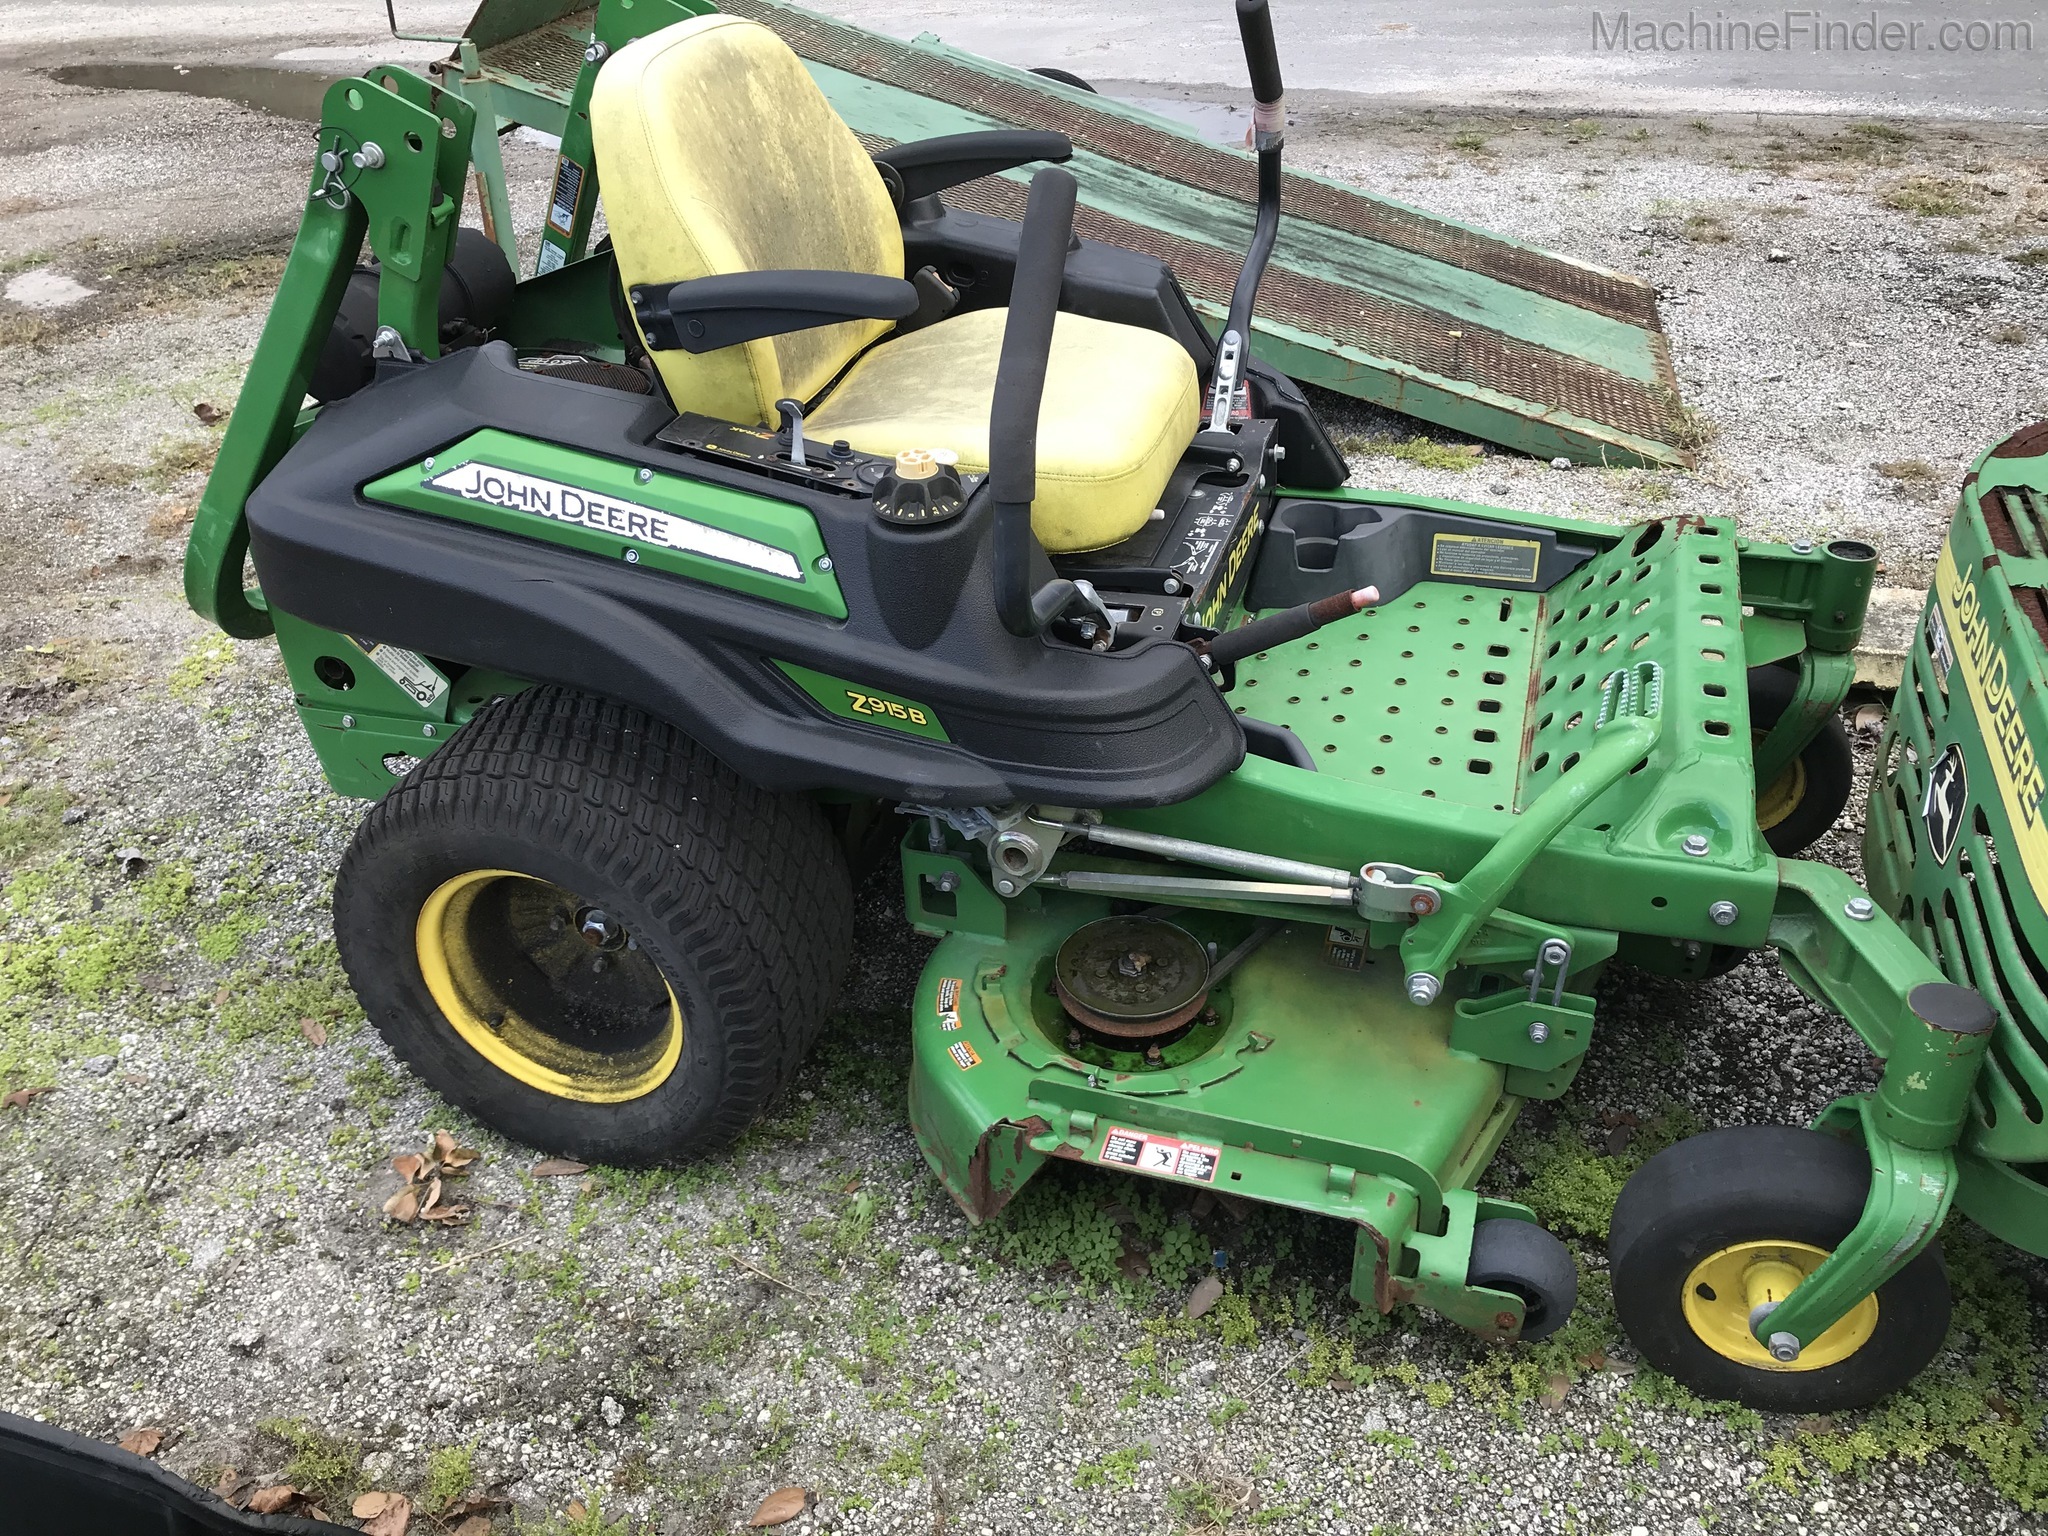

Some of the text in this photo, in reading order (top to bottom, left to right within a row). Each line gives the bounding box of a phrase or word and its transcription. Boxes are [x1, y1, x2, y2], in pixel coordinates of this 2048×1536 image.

[465, 470, 669, 542] JOHN DEERE
[1228, 501, 1260, 588] DEERE
[846, 690, 928, 725] Z915B
[1951, 563, 2046, 831] JOHN DEERE
[1119, 1130, 1149, 1141] DANGER
[1187, 1143, 1220, 1156] PELIGRO
